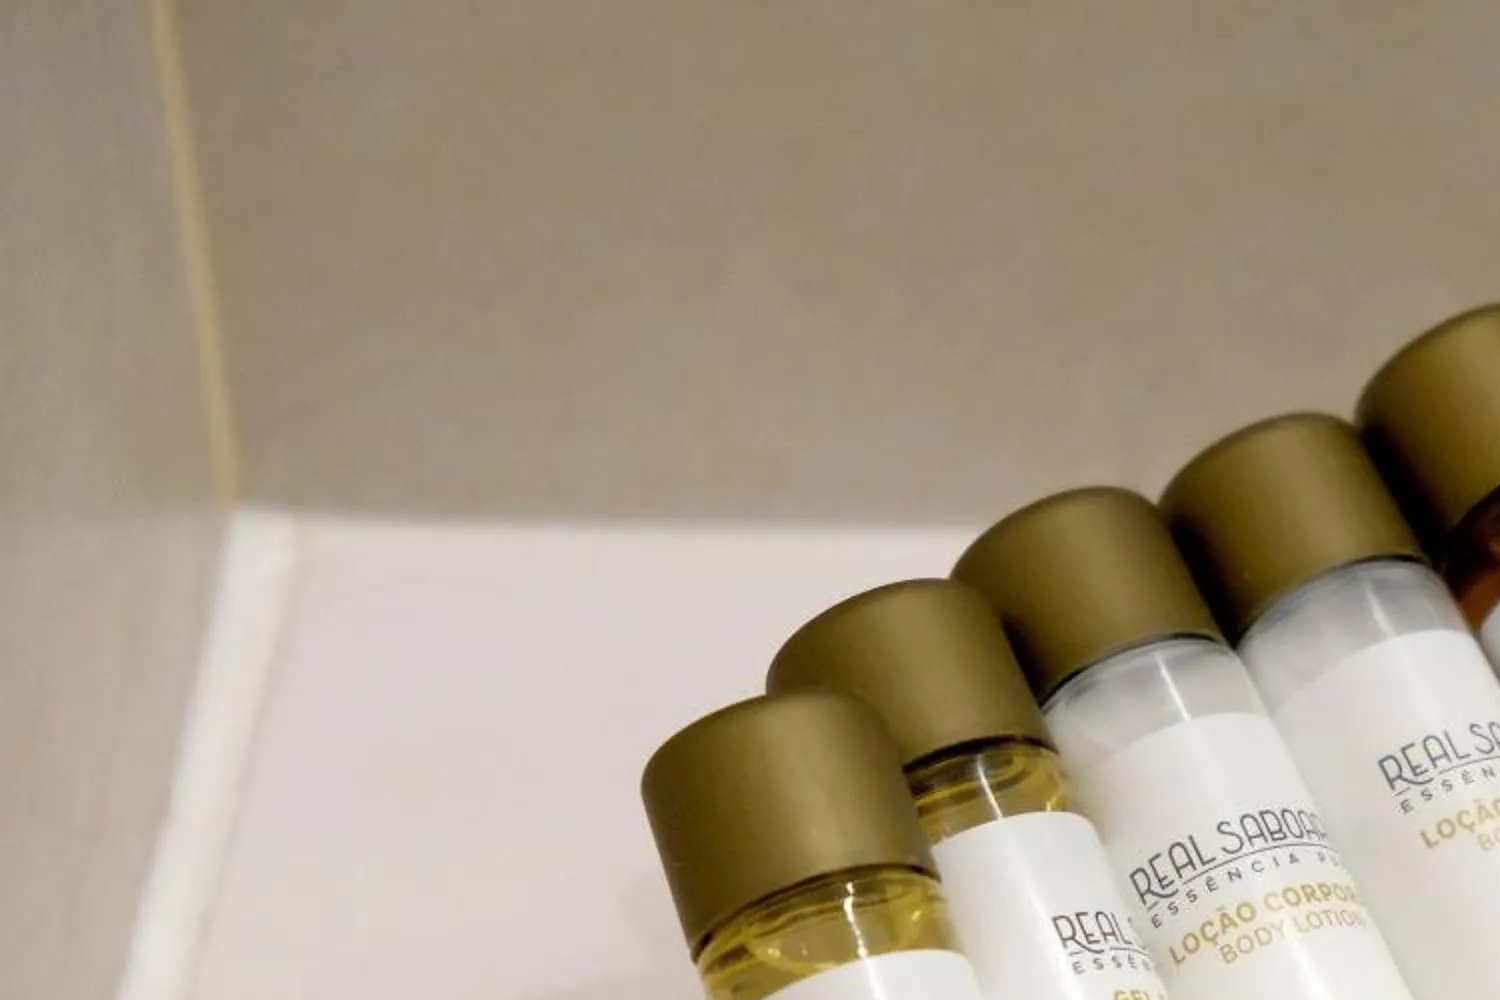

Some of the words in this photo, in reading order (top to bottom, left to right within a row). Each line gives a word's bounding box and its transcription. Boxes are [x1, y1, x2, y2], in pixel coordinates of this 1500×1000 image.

[1377, 730, 1471, 790] REAL
[1129, 834, 1217, 906] REAL
[1051, 911, 1136, 954] REAL
[1168, 901, 1256, 967] LOÇÃO
[1218, 921, 1285, 966] BODY
